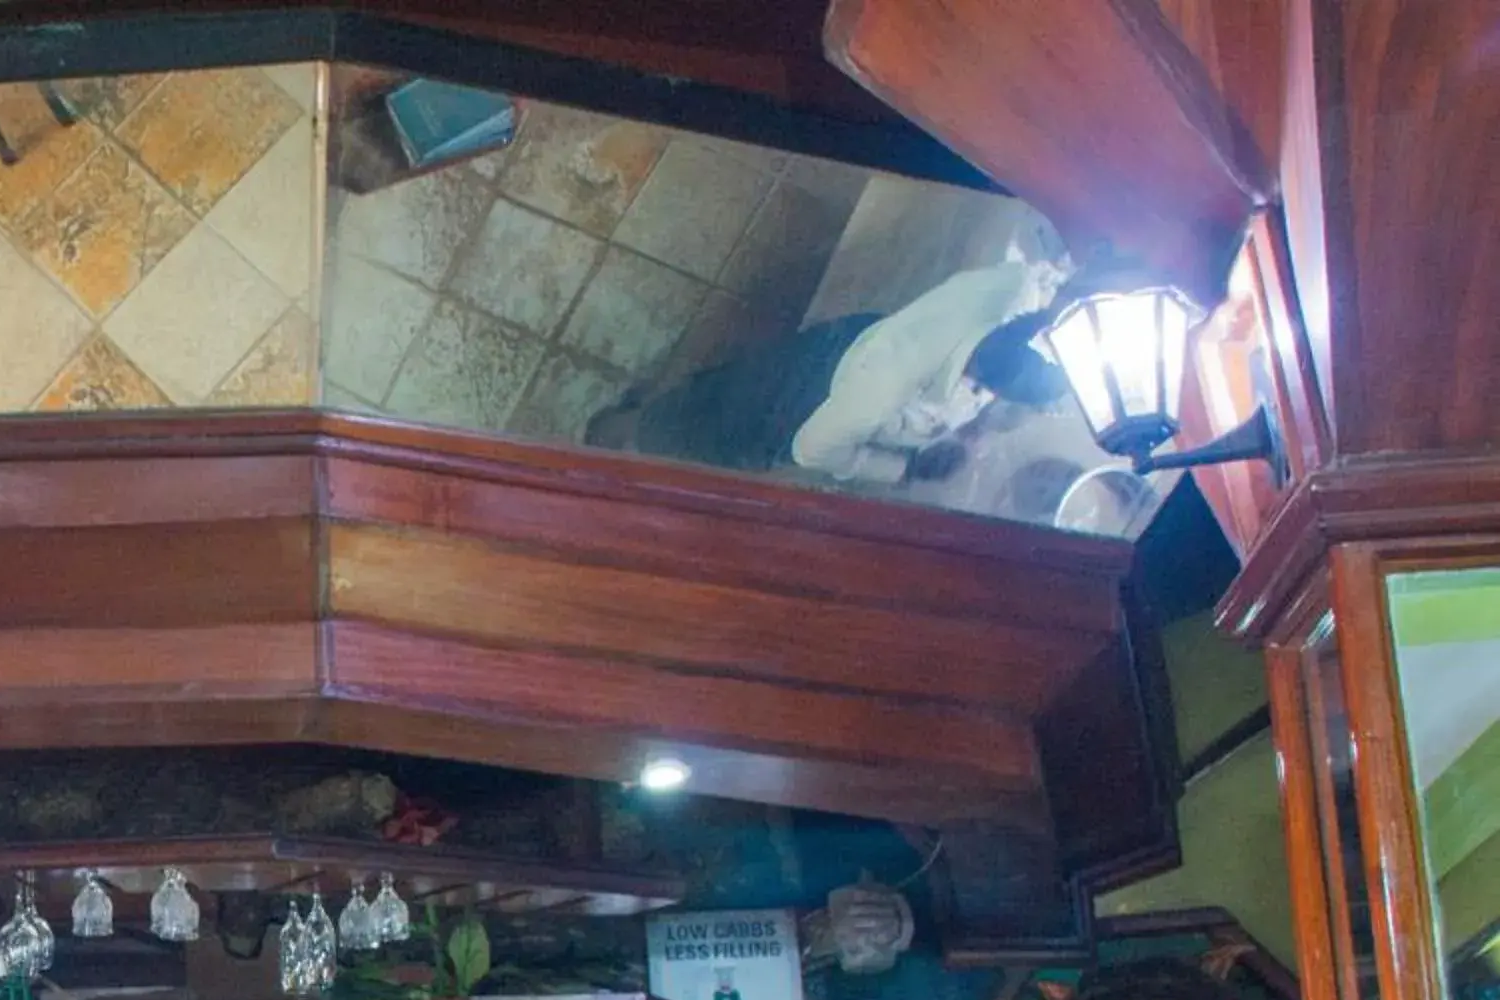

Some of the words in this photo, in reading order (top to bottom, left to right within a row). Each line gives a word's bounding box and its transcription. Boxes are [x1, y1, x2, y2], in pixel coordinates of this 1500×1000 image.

[666, 923, 708, 942] LOW
[665, 944, 708, 961] LESS
[713, 941, 783, 960] FILLING
